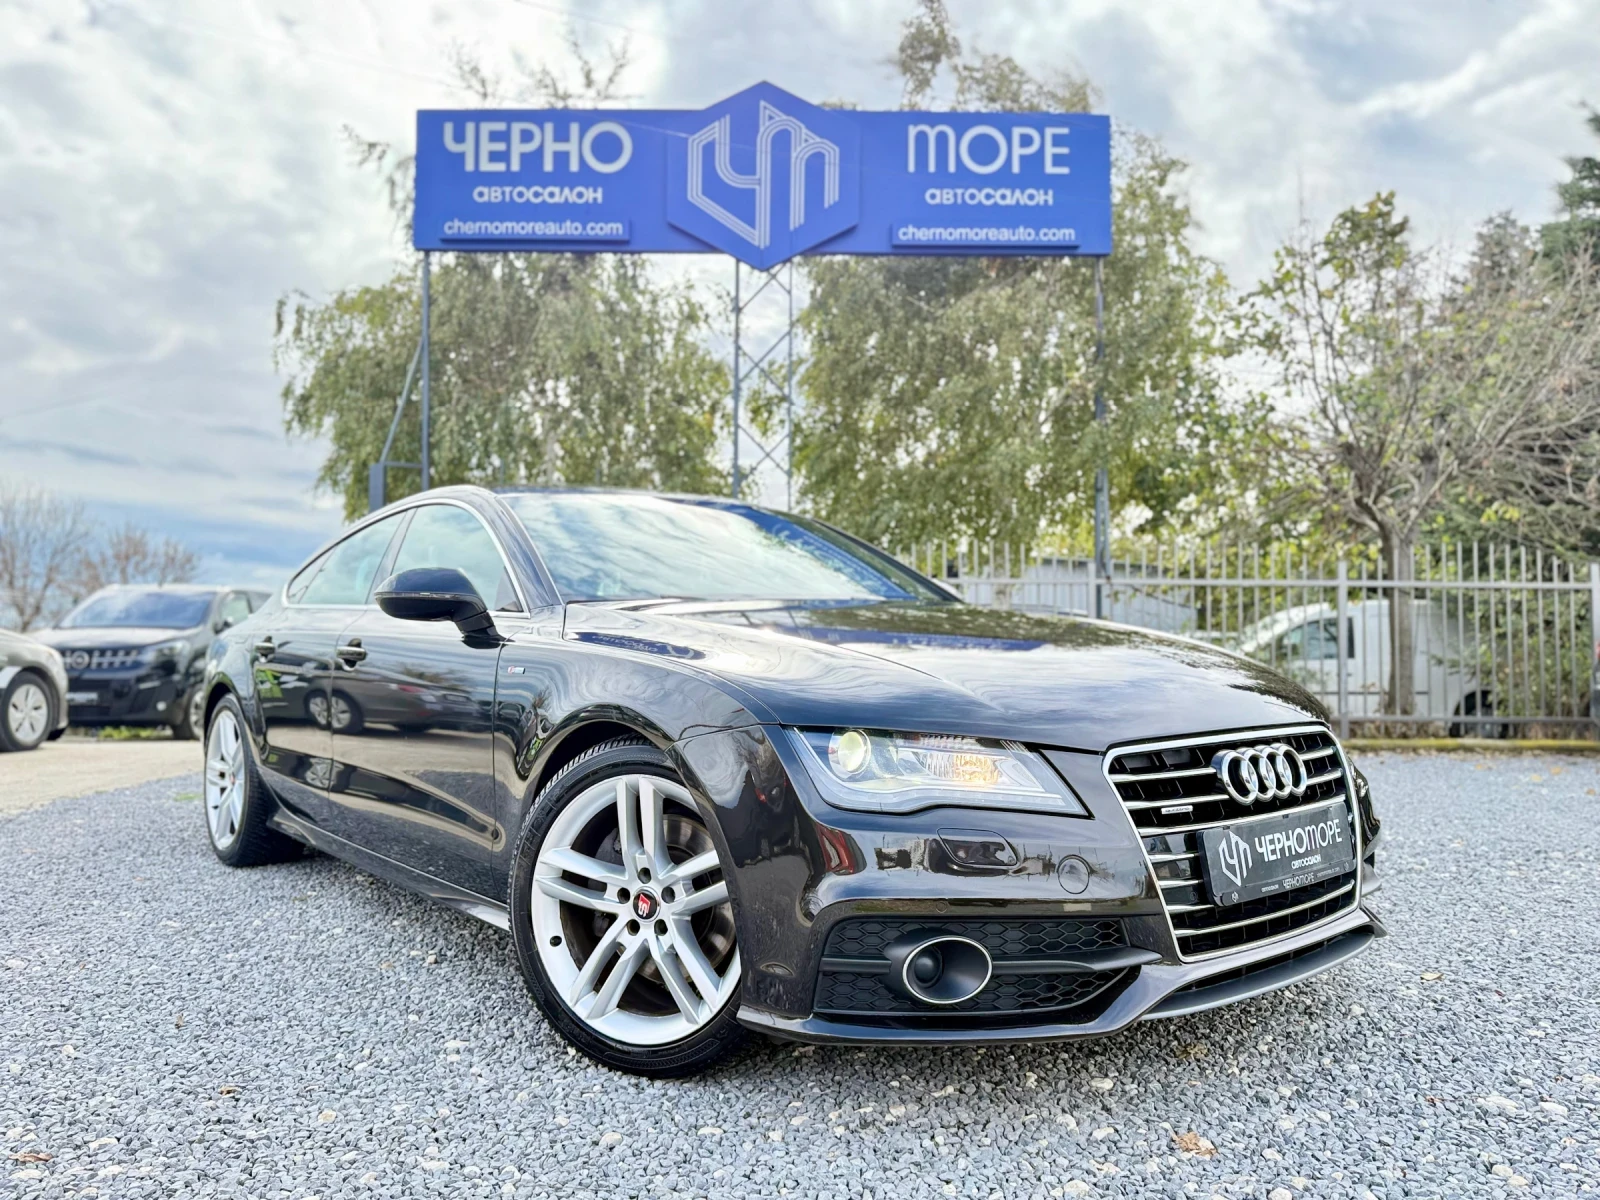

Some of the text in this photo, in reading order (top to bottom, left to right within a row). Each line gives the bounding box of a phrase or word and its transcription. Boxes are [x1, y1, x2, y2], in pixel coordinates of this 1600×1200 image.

[443, 121, 633, 174] ЧЕРНО
[472, 186, 603, 204] автосалон
[925, 188, 1053, 206] автосалон
[443, 218, 623, 236] chernomoreauto.com
[898, 224, 1075, 242] chernomoreauto.com
